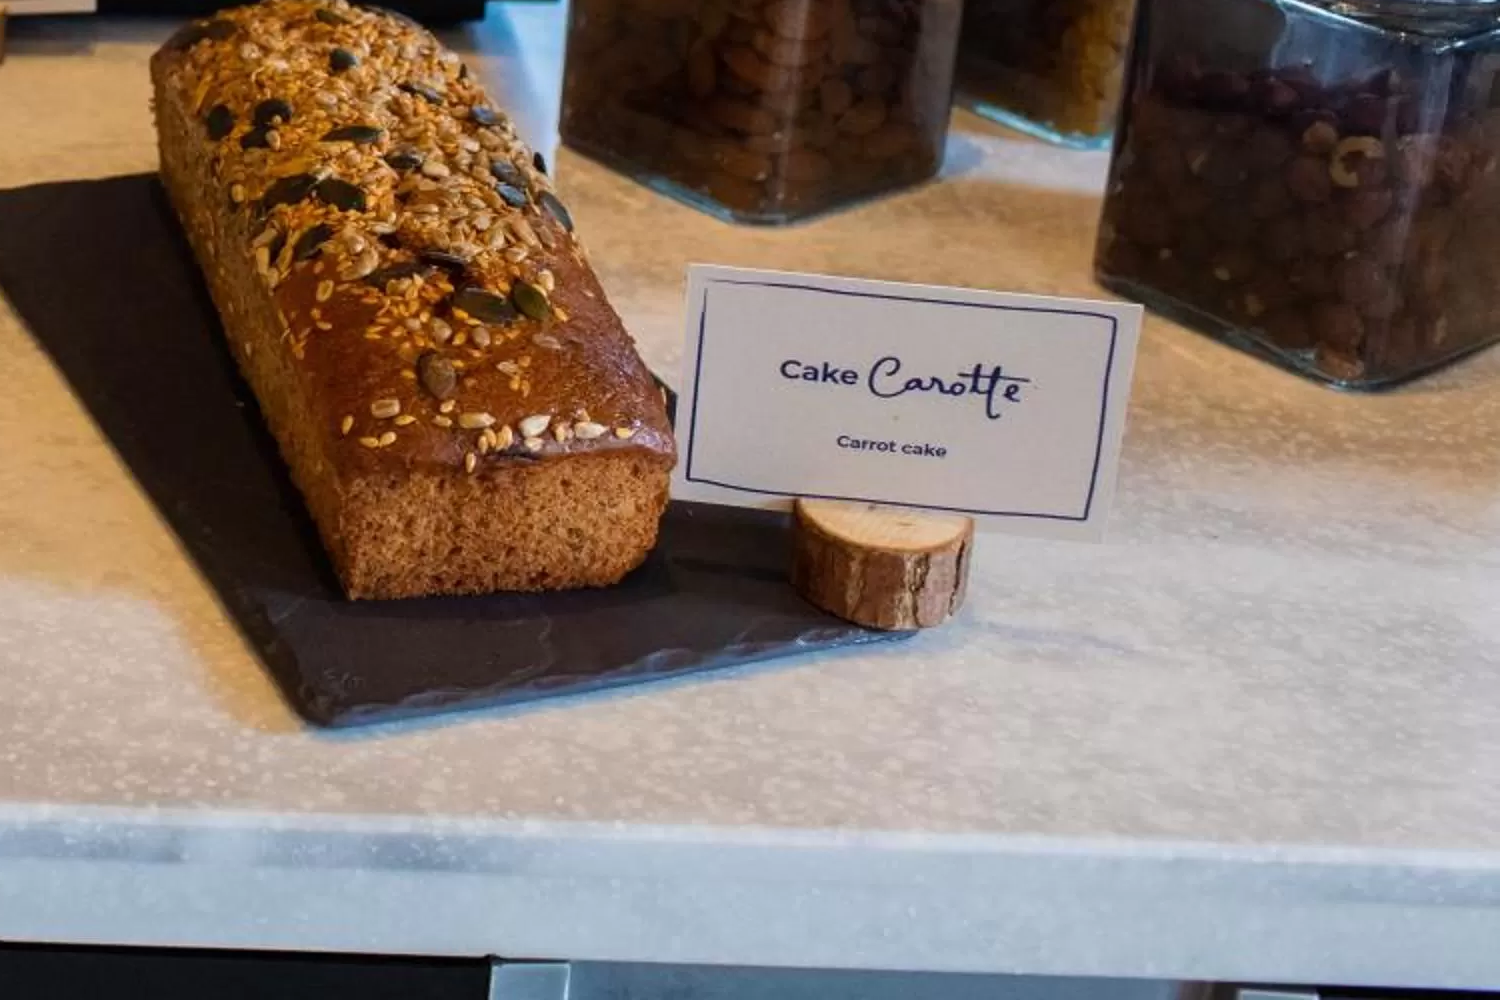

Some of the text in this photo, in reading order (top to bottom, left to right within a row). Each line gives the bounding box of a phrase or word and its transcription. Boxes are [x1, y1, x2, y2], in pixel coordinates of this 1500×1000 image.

[780, 356, 1031, 420] Cake Carotte
[836, 435, 947, 459] Carrot cake
